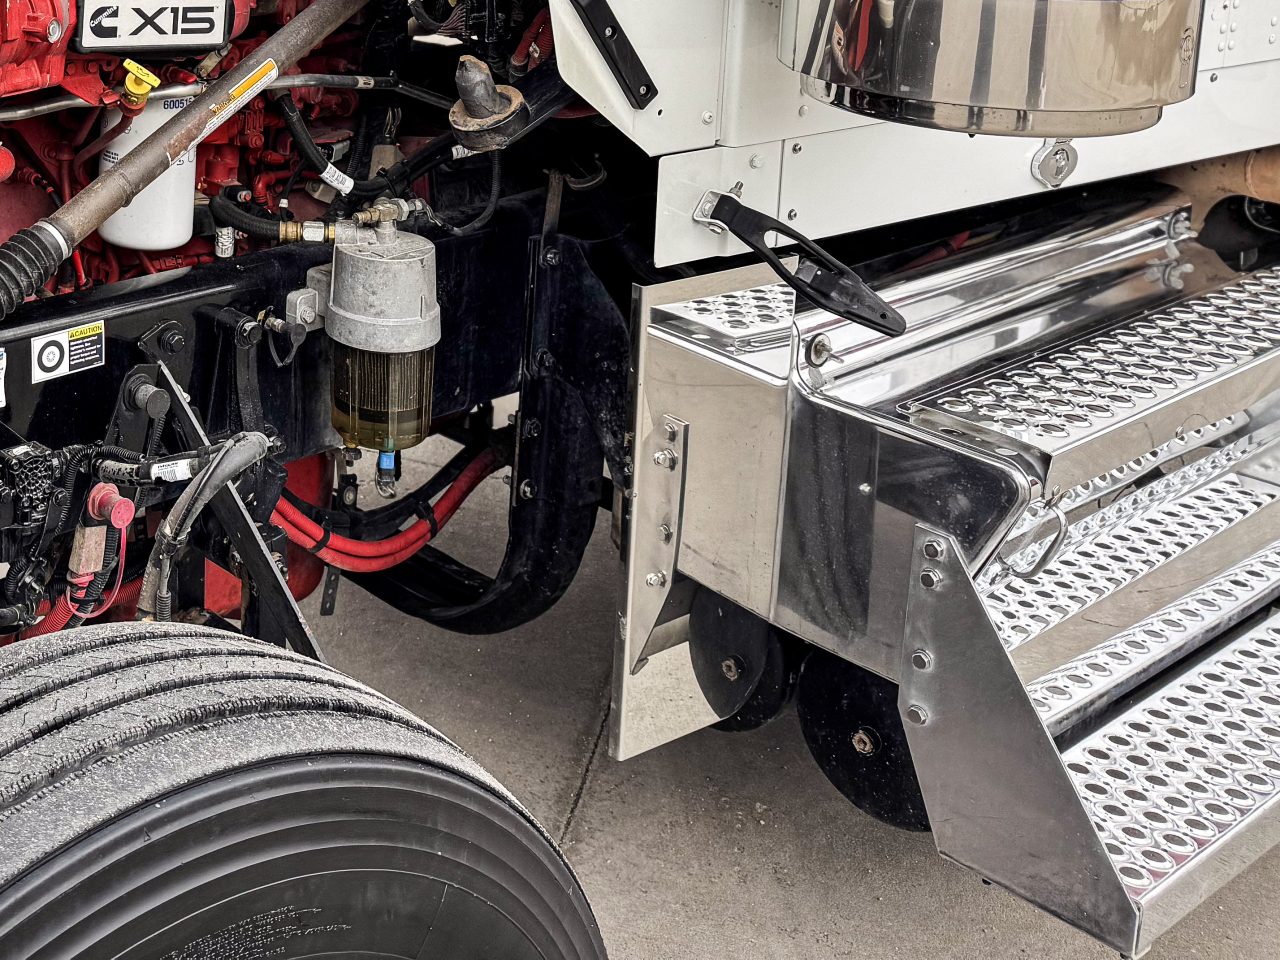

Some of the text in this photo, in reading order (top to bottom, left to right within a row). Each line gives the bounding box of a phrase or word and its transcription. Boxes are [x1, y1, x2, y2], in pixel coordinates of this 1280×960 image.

[90, 5, 216, 36] Cummins X15
[75, 325, 102, 338] CAUTION
